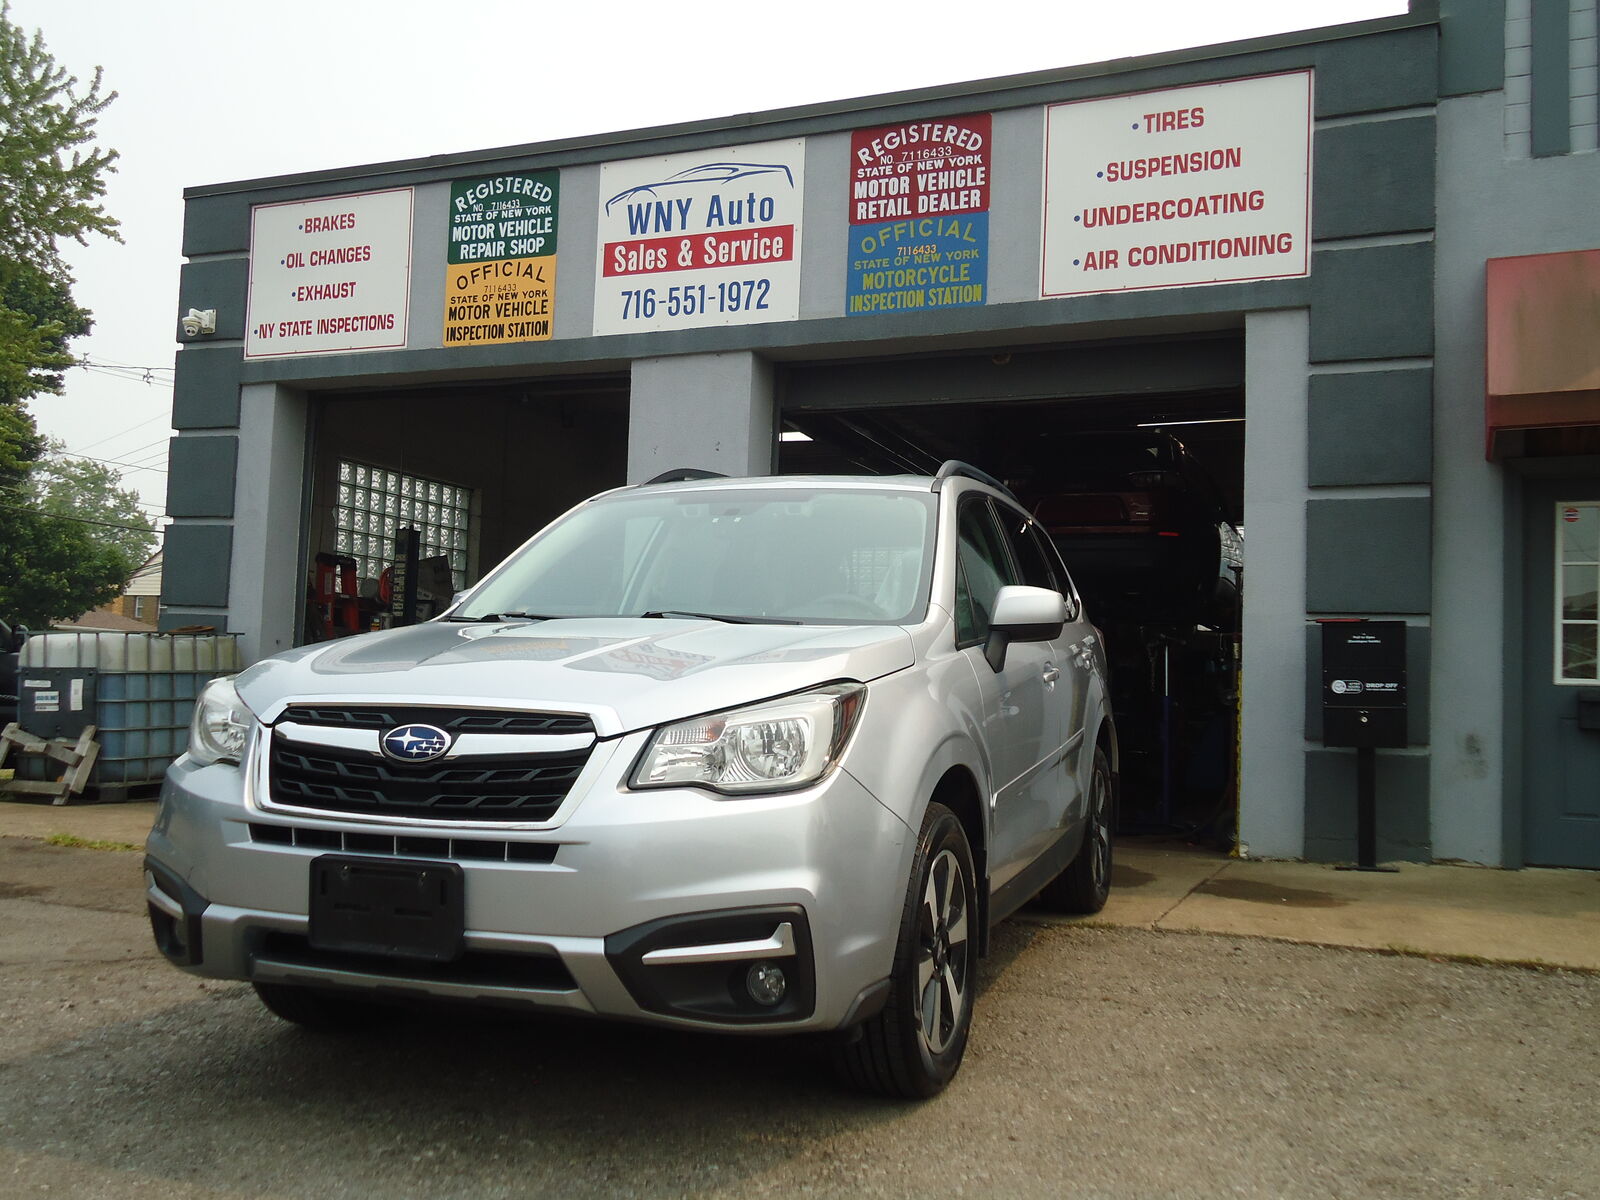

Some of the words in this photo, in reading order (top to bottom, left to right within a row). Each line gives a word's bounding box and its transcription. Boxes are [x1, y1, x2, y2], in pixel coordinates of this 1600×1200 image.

[1143, 107, 1204, 134] TIRES
[857, 124, 983, 166] REGISTERED
[902, 146, 952, 161] 7116433
[857, 165, 892, 178] STATE
[898, 163, 913, 173] OF
[917, 159, 944, 171] NEW
[949, 154, 982, 167] YORK
[1106, 147, 1242, 182] SUSPENSION
[455, 176, 552, 212] REGISTERED
[854, 176, 910, 199] MOTOR
[917, 167, 986, 192] VEHICLE
[454, 214, 482, 223] STATE
[486, 211, 498, 220] OF
[502, 208, 523, 219] NEW
[526, 205, 552, 215] YORK
[491, 199, 520, 210] 7116433
[627, 198, 693, 235] WNY
[706, 192, 774, 227] Auto
[857, 197, 912, 220] RETAIL
[918, 189, 981, 214] DEALER
[1083, 190, 1265, 228] UNDERCOATING
[305, 213, 355, 233] BRAKES
[452, 222, 495, 242] MOTOR
[499, 217, 553, 238] VEHICLE
[861, 218, 977, 253] OFFICIAL
[286, 253, 305, 268] OIL
[310, 246, 371, 266] CHANGES
[460, 241, 505, 259] REPAIR
[510, 237, 545, 255] SHOP
[614, 244, 667, 272] Sales
[678, 239, 693, 267] &
[704, 233, 783, 265] Service
[854, 259, 890, 270] STATE
[894, 256, 911, 266] OF
[914, 253, 941, 264] NEW
[946, 249, 979, 260] YORK
[897, 245, 937, 255] 7116433
[1083, 249, 1119, 271] AIR
[1128, 232, 1292, 267] CONDITIONING
[457, 261, 545, 290] OFFICIAL
[484, 284, 517, 292] 7116433
[863, 263, 970, 290] MOTORCYCLE
[298, 282, 356, 301] EXHAUST
[450, 296, 478, 304] STATE
[482, 294, 493, 302] OF
[498, 292, 518, 300] NEW
[523, 289, 548, 298] YORK
[621, 279, 771, 319] 716-551-1972
[850, 289, 924, 312] INSPECTION
[929, 284, 982, 305] STATION
[448, 304, 490, 321] MOTOR
[496, 299, 548, 318] VEHICLE
[259, 323, 275, 338] NY
[279, 320, 312, 337] STATE
[317, 314, 394, 334] INSPECTIONS
[446, 324, 505, 342] INSPECTION
[508, 320, 549, 338] STATION
